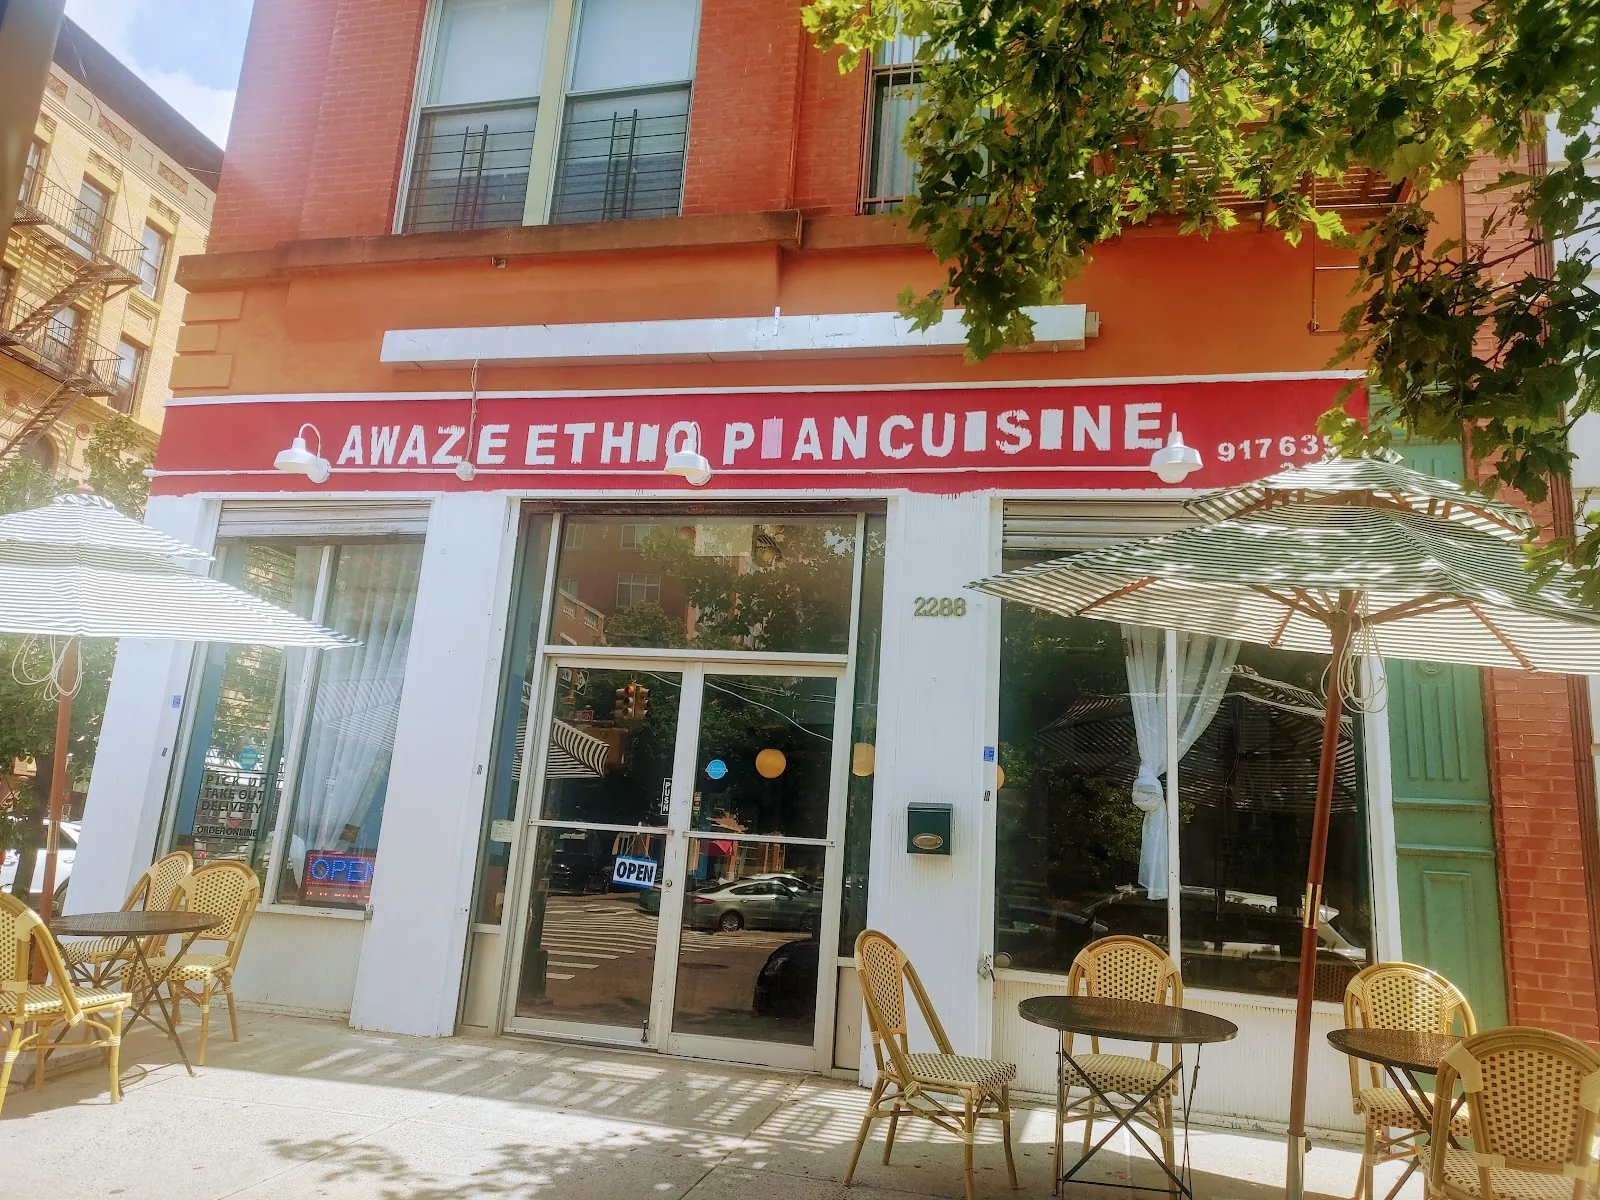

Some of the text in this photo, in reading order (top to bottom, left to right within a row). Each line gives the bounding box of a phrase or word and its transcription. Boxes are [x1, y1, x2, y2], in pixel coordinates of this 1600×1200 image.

[336, 424, 510, 466] AWAZE
[525, 421, 698, 465] ETHIO
[914, 597, 967, 616] 2288
[206, 774, 266, 788] PICK UP
[205, 788, 264, 801] TAKE OUT
[663, 782, 671, 812] PUSH
[201, 801, 262, 814] DELIVERY
[197, 826, 257, 837] ORDER ONLINE
[616, 861, 654, 883] OPEN
